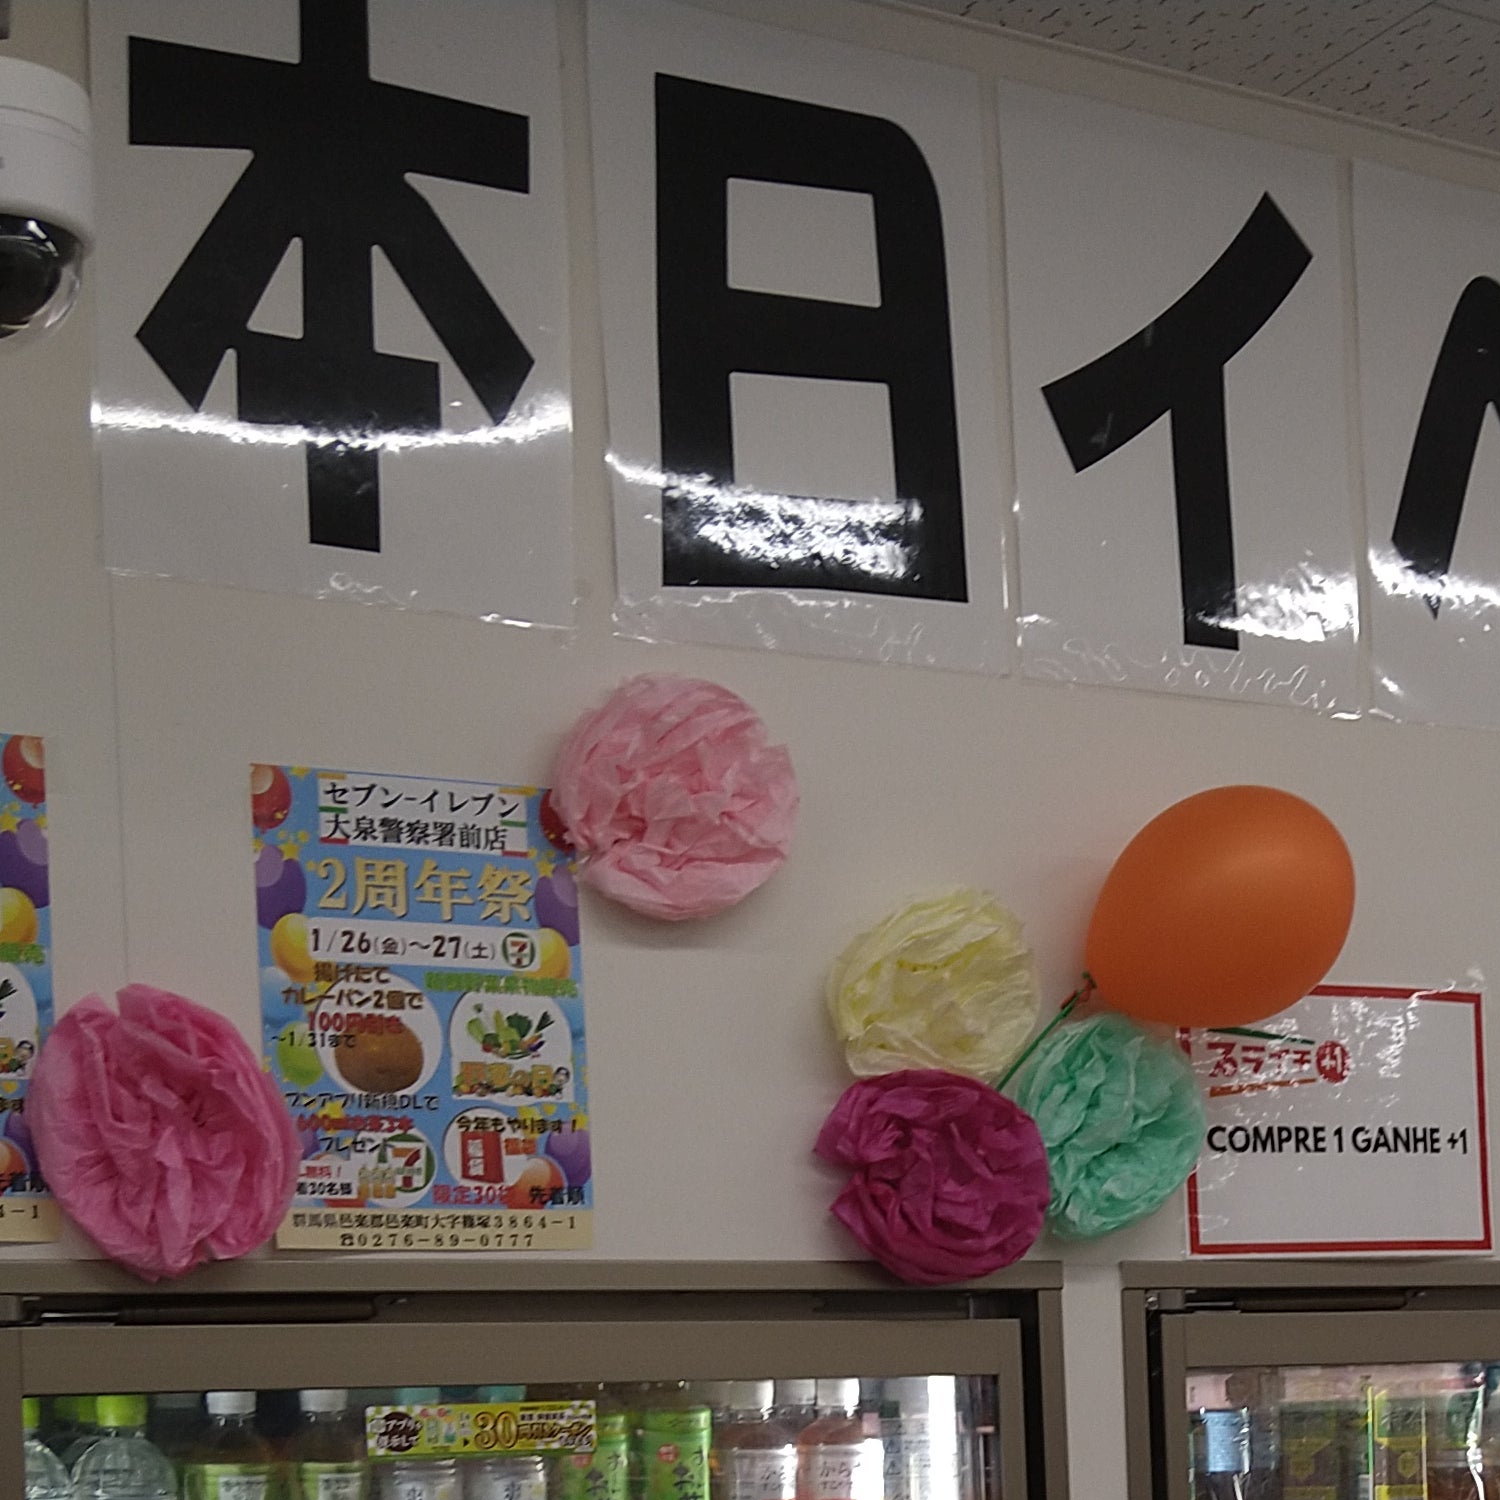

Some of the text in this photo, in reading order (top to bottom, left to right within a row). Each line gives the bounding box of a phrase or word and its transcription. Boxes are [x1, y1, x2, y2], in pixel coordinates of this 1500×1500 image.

[324, 813, 507, 851] 大泉警察署前店
[316, 856, 534, 924] 2周年祭
[1206, 1125, 1469, 1155] COMPRE 1 GANHE +1
[473, 1411, 518, 1450] 30
